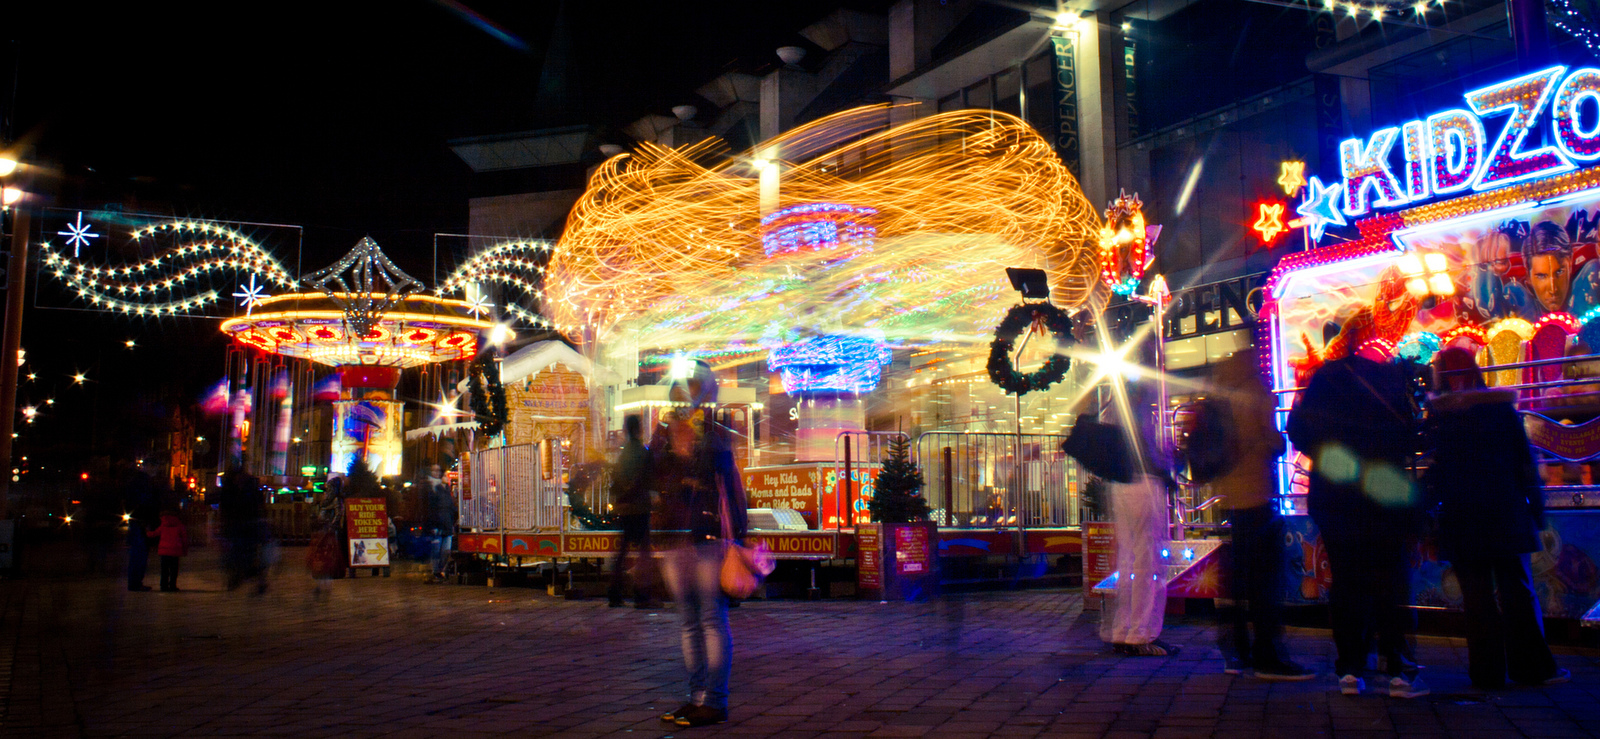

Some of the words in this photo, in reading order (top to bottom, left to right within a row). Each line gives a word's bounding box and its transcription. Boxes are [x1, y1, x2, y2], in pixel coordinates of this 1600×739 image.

[1056, 40, 1078, 151] SPENCER
[763, 474, 779, 488] Hey
[780, 471, 798, 485] Kids
[750, 487, 774, 499] Moms
[774, 486, 789, 498] and
[790, 484, 813, 497] Dads
[756, 499, 771, 509] Can
[772, 498, 790, 510] Ride
[791, 497, 806, 510] Too
[568, 536, 610, 552] STAND
[762, 537, 777, 552] IN
[778, 536, 833, 552] MOTION
